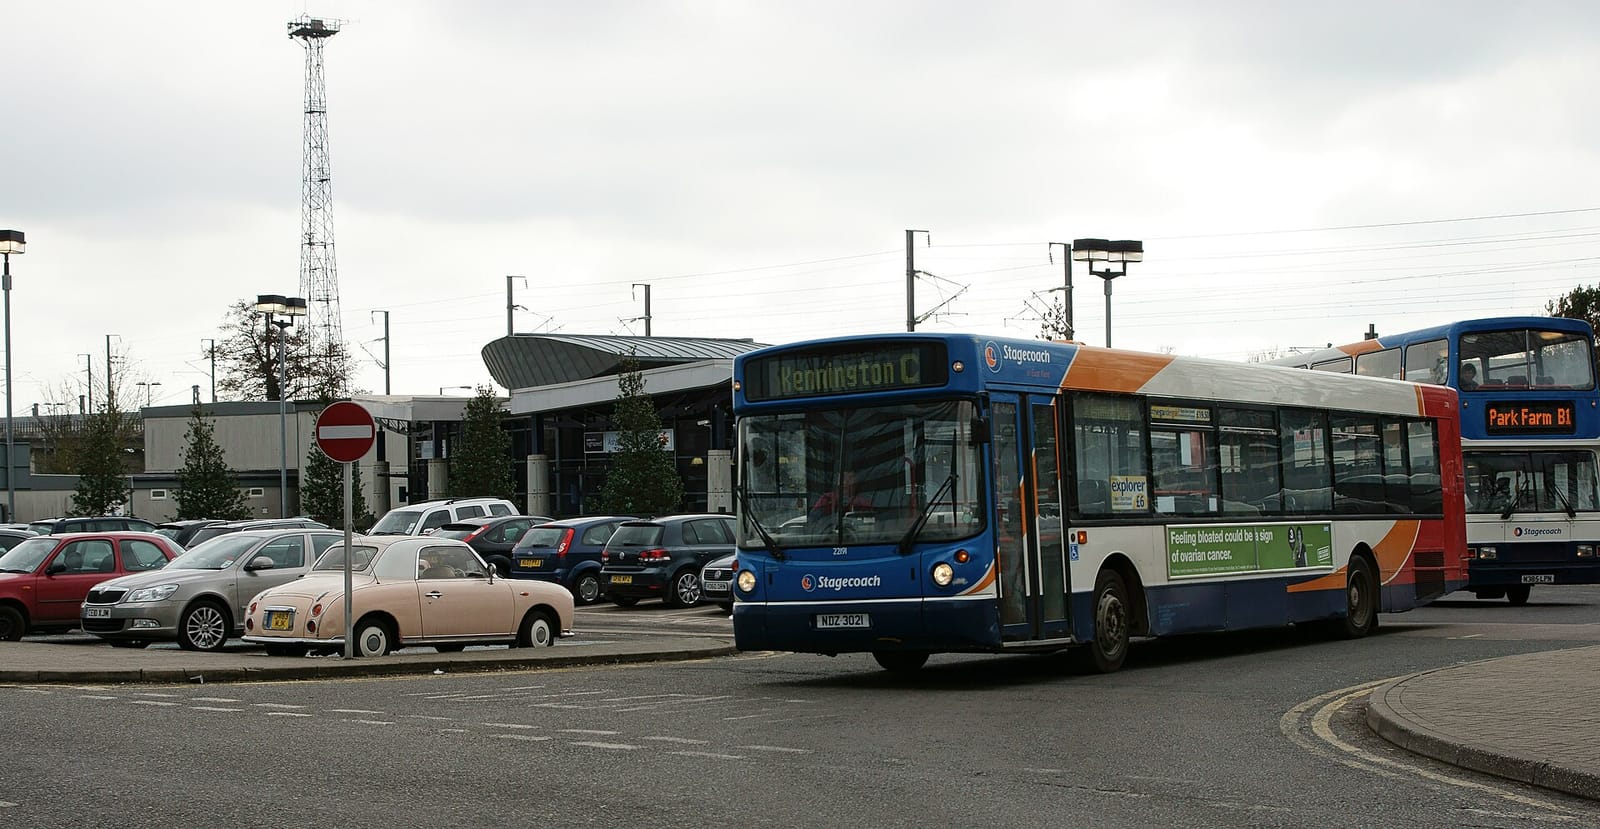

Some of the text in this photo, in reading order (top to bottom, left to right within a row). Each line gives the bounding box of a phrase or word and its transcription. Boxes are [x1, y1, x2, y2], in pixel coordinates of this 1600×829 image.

[1003, 344, 1050, 365] Stagecoach
[781, 354, 919, 393] Kennington C
[1489, 407, 1571, 426] Park Farm B1
[1111, 477, 1146, 496] explorer
[1136, 495, 1145, 508] £6
[1170, 529, 1273, 546] Feeling bloated could be a sign
[1523, 527, 1562, 537] Stagecoach
[1171, 549, 1232, 563] of ovarian cancer.
[818, 575, 881, 591] Stagecoach
[821, 615, 864, 626] NDZ 3021
